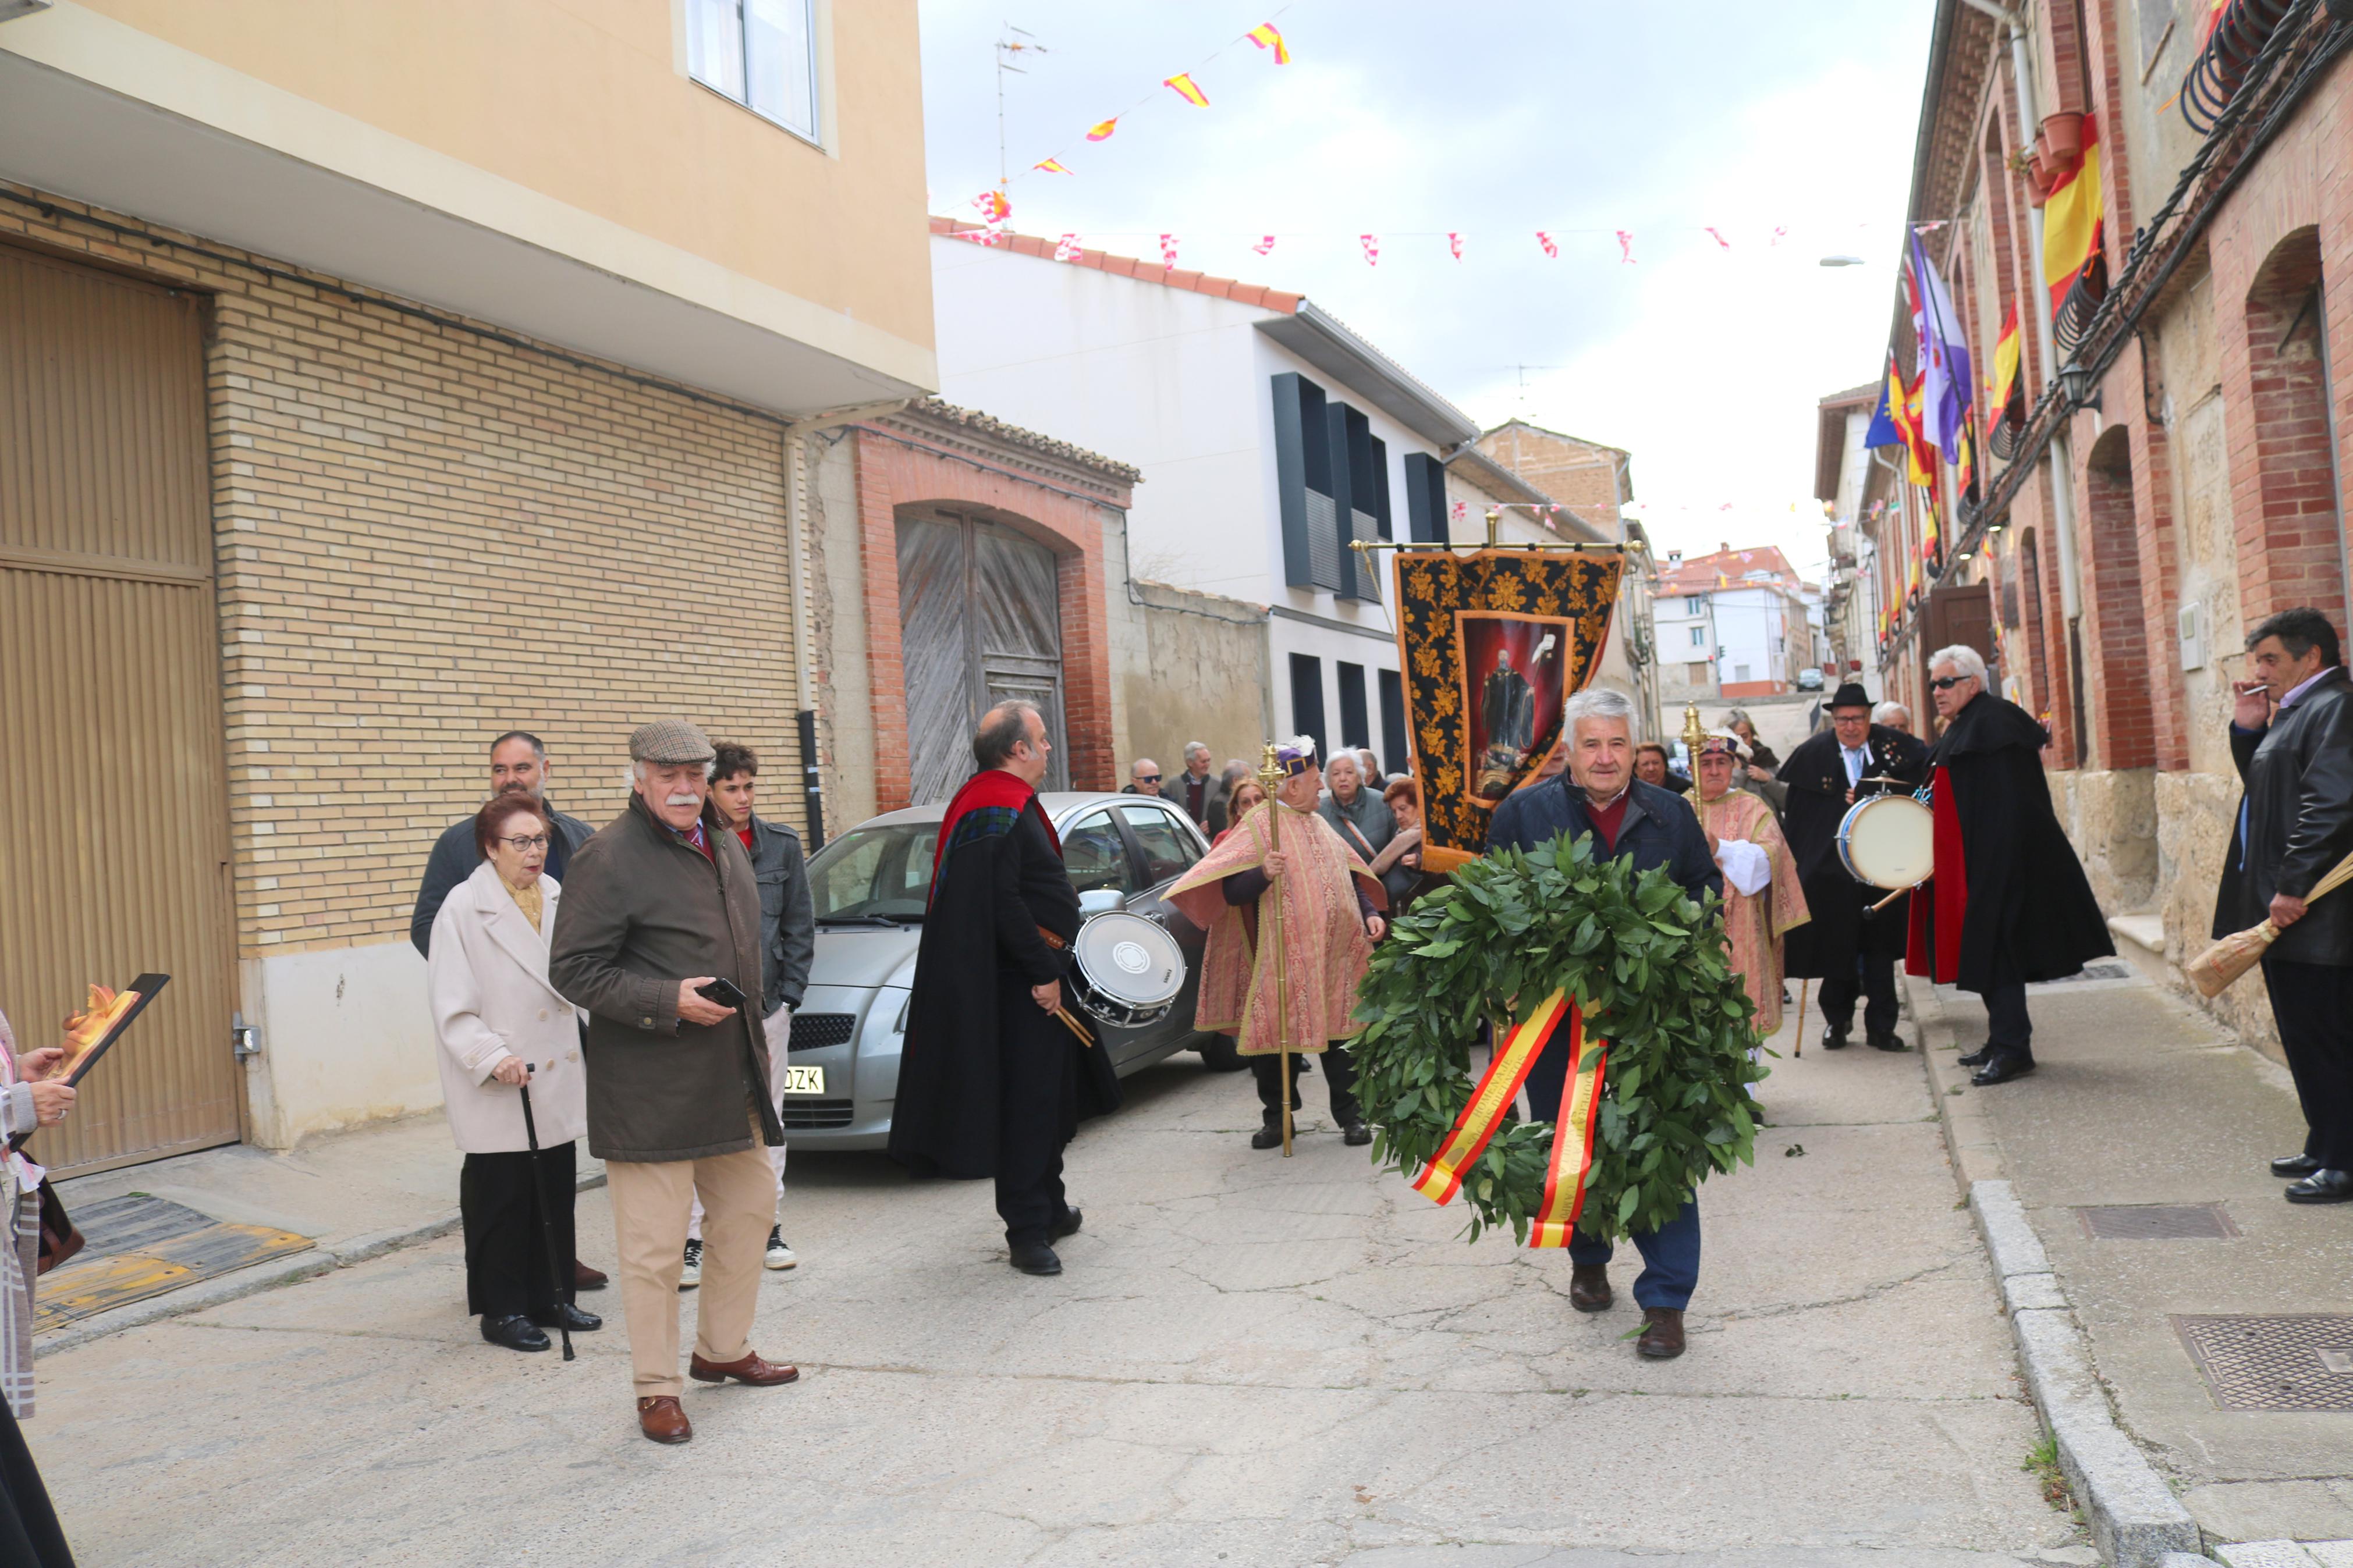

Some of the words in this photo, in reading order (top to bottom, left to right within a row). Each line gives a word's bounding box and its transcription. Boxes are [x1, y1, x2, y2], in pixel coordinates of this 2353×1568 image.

[1467, 1108, 1495, 1145] SOCIOS
[1491, 1054, 1526, 1107] DIFUNTOS
[1473, 1057, 1513, 1118] HOMENAJE
